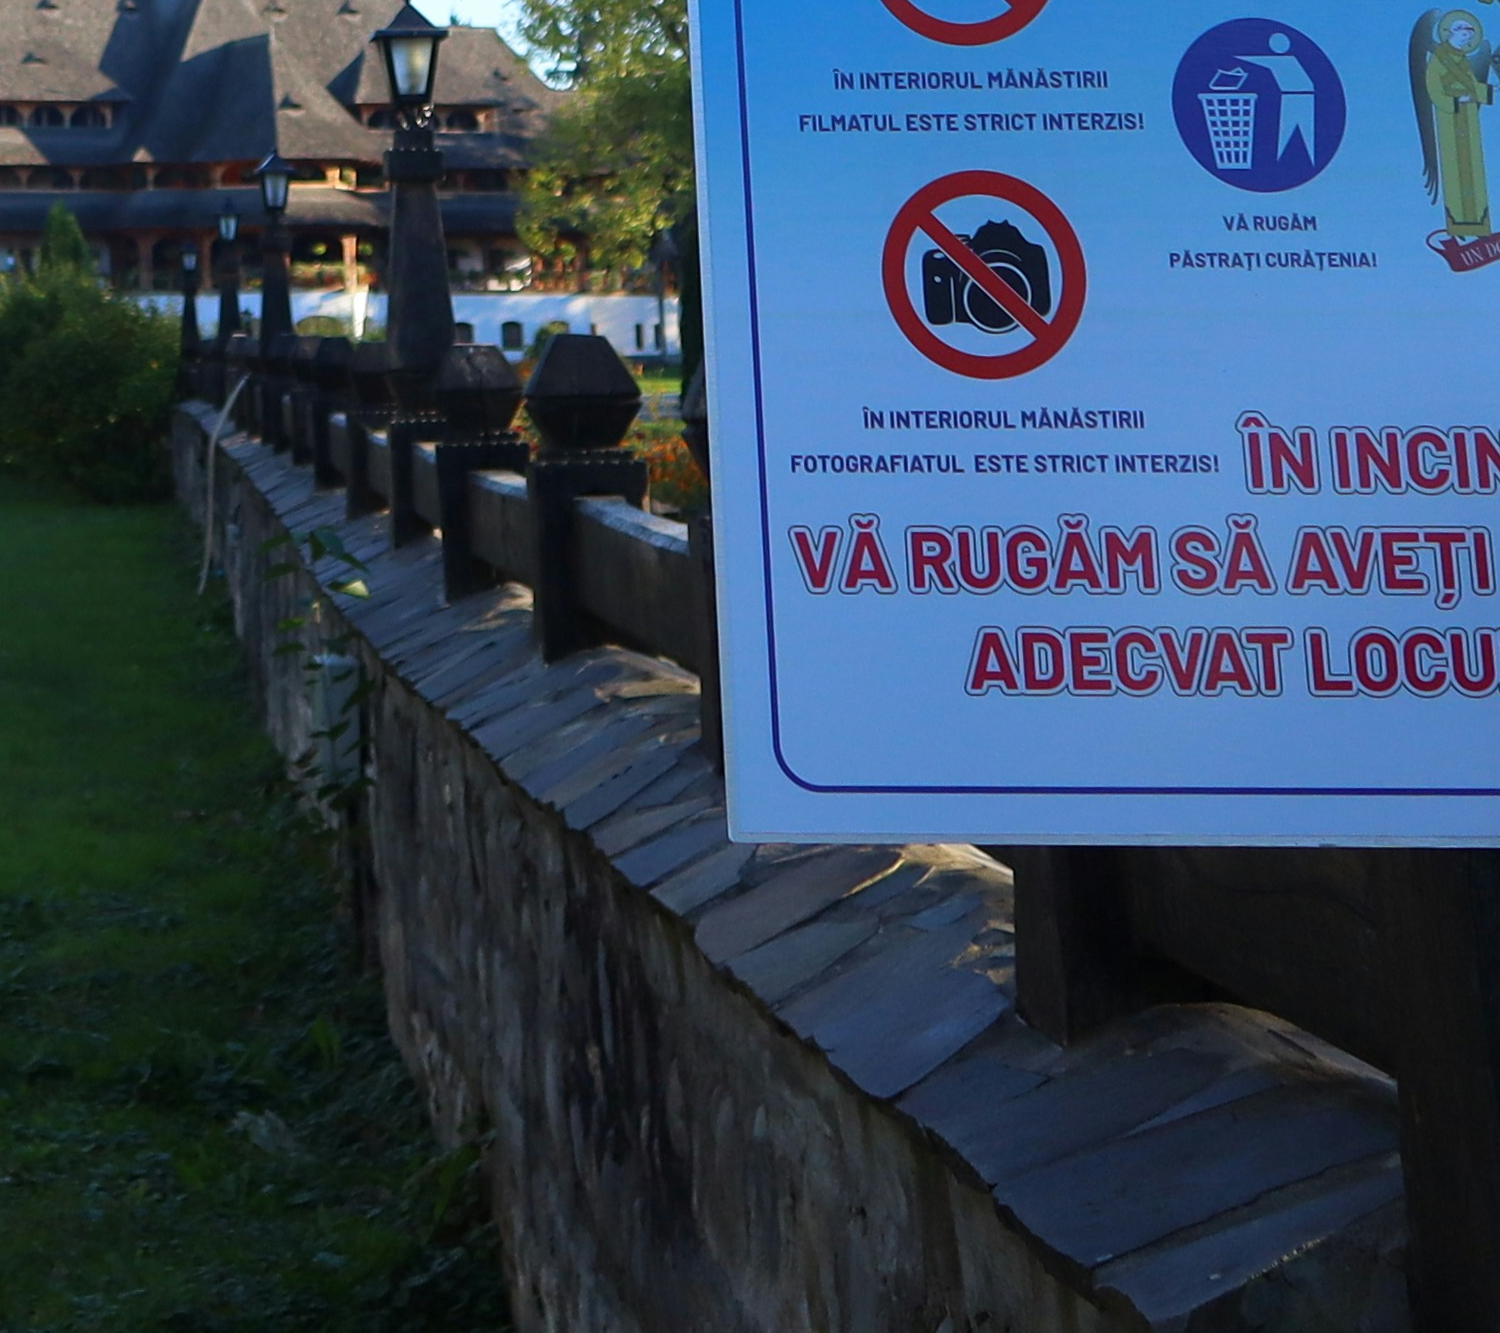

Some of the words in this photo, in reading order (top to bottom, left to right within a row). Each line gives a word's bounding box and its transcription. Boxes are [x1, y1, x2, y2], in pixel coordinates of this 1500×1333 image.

[832, 68, 855, 90] ÎN
[859, 71, 983, 90] INTERIORUL
[987, 67, 1108, 89] MĂNĂSTIRII
[798, 114, 902, 133] FILMATUL
[905, 113, 960, 132] ESTE
[963, 113, 1037, 132] STRICT
[1042, 112, 1145, 131] INTERZIS!
[1222, 212, 1250, 232] VĂ
[1252, 212, 1317, 232] RUGĂM
[1169, 249, 1261, 272] PĂSTRAȚI
[1264, 249, 1378, 272] CURĂȚENIA!
[862, 406, 885, 429] ÎN
[889, 410, 1017, 429] INTERIORUL
[1020, 406, 1145, 429] MĂNĂSTIRII
[790, 454, 965, 474] FOTOGRAFIATUL
[974, 454, 1029, 474] ESTE
[1033, 454, 1110, 474] STRICT
[1114, 454, 1220, 474] INTERZIS!
[1240, 412, 1322, 496] ÎN
[792, 516, 898, 596] VĂ
[909, 517, 1162, 595] RUGĂM
[1172, 516, 1278, 596] SĂ
[1285, 527, 1497, 610] AVEȚI
[970, 628, 1295, 696] ADECVAT
